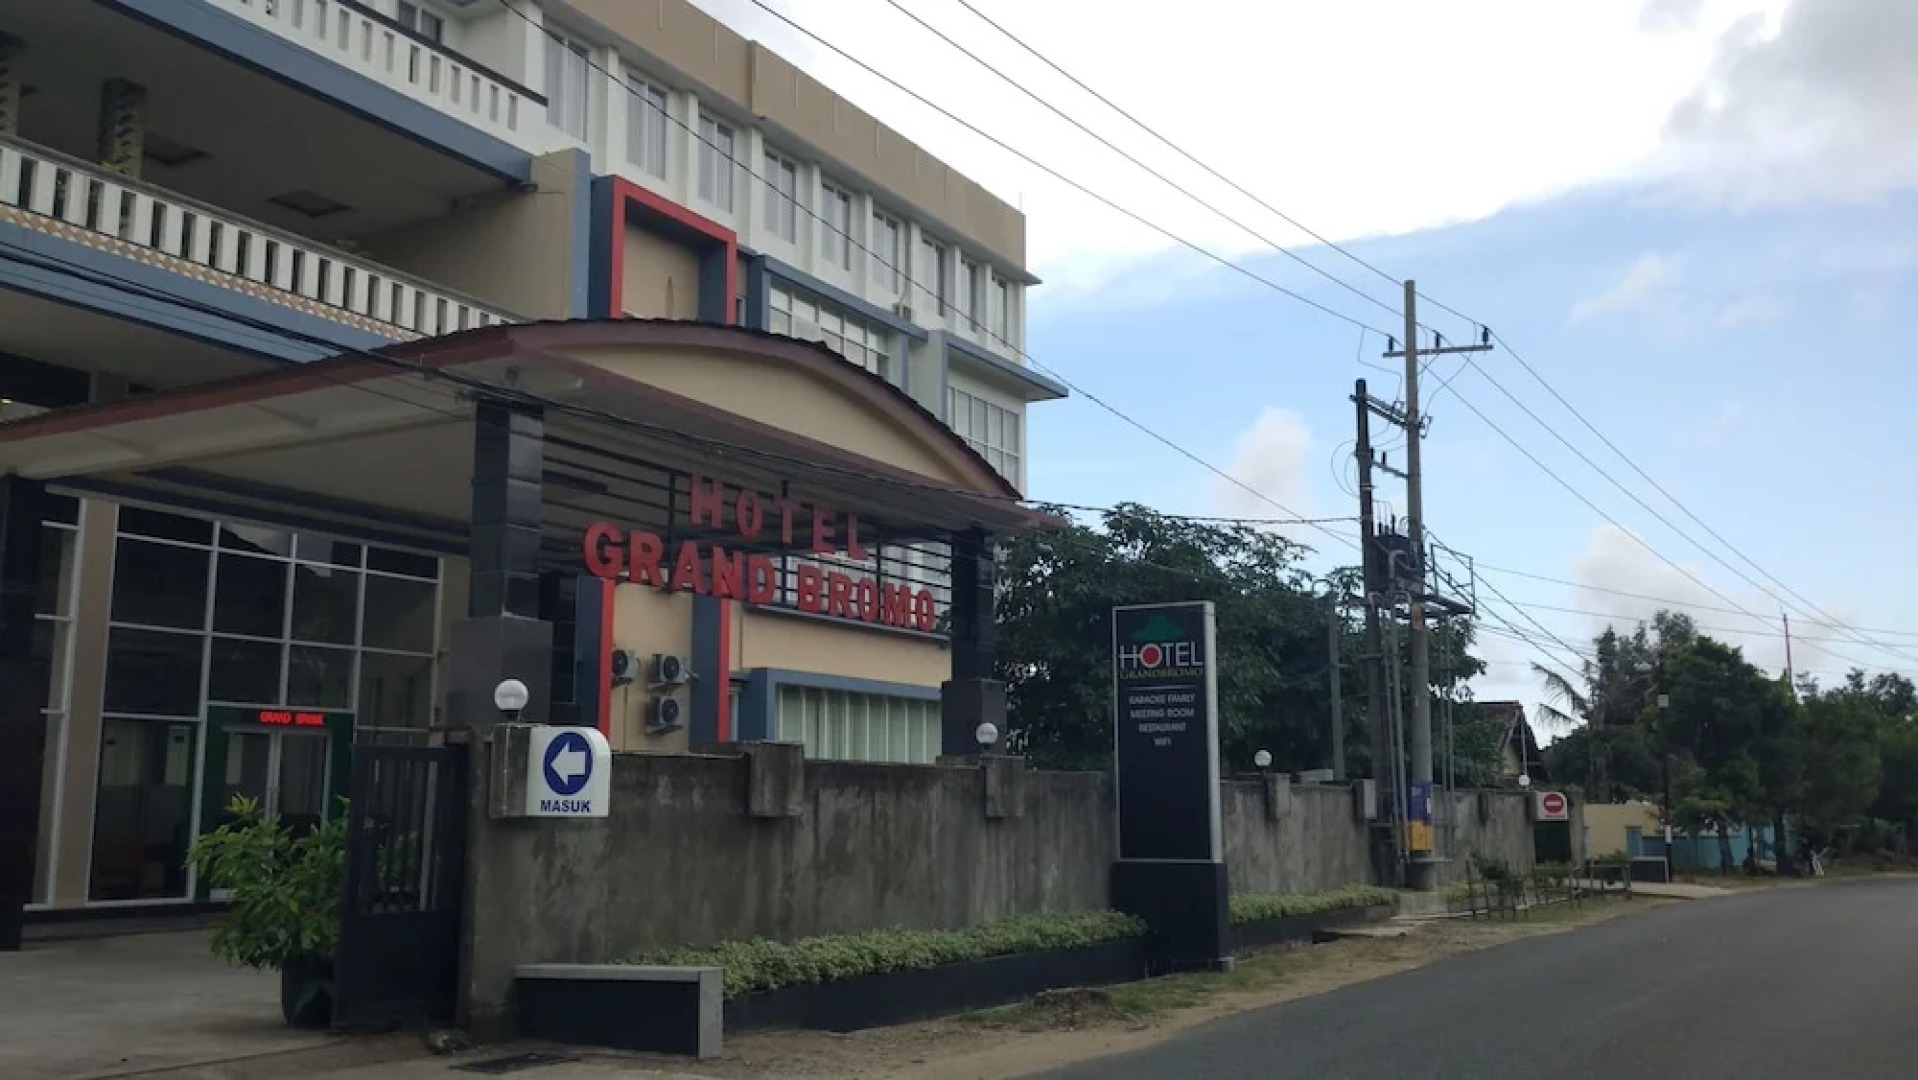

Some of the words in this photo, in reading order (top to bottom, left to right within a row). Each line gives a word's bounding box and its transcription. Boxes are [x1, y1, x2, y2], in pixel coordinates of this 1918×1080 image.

[689, 475, 868, 560] HOTEL
[582, 521, 776, 604] GRAND
[797, 563, 936, 631] BROMO
[1118, 641, 1204, 668] HOTEL
[1129, 695, 1166, 705] KARAOKE
[1167, 693, 1196, 703] FAMILY
[1129, 709, 1165, 718] MEETING
[1167, 707, 1194, 717] ROOM
[1138, 722, 1186, 732] RESTAURANT
[540, 799, 591, 813] MASUK
